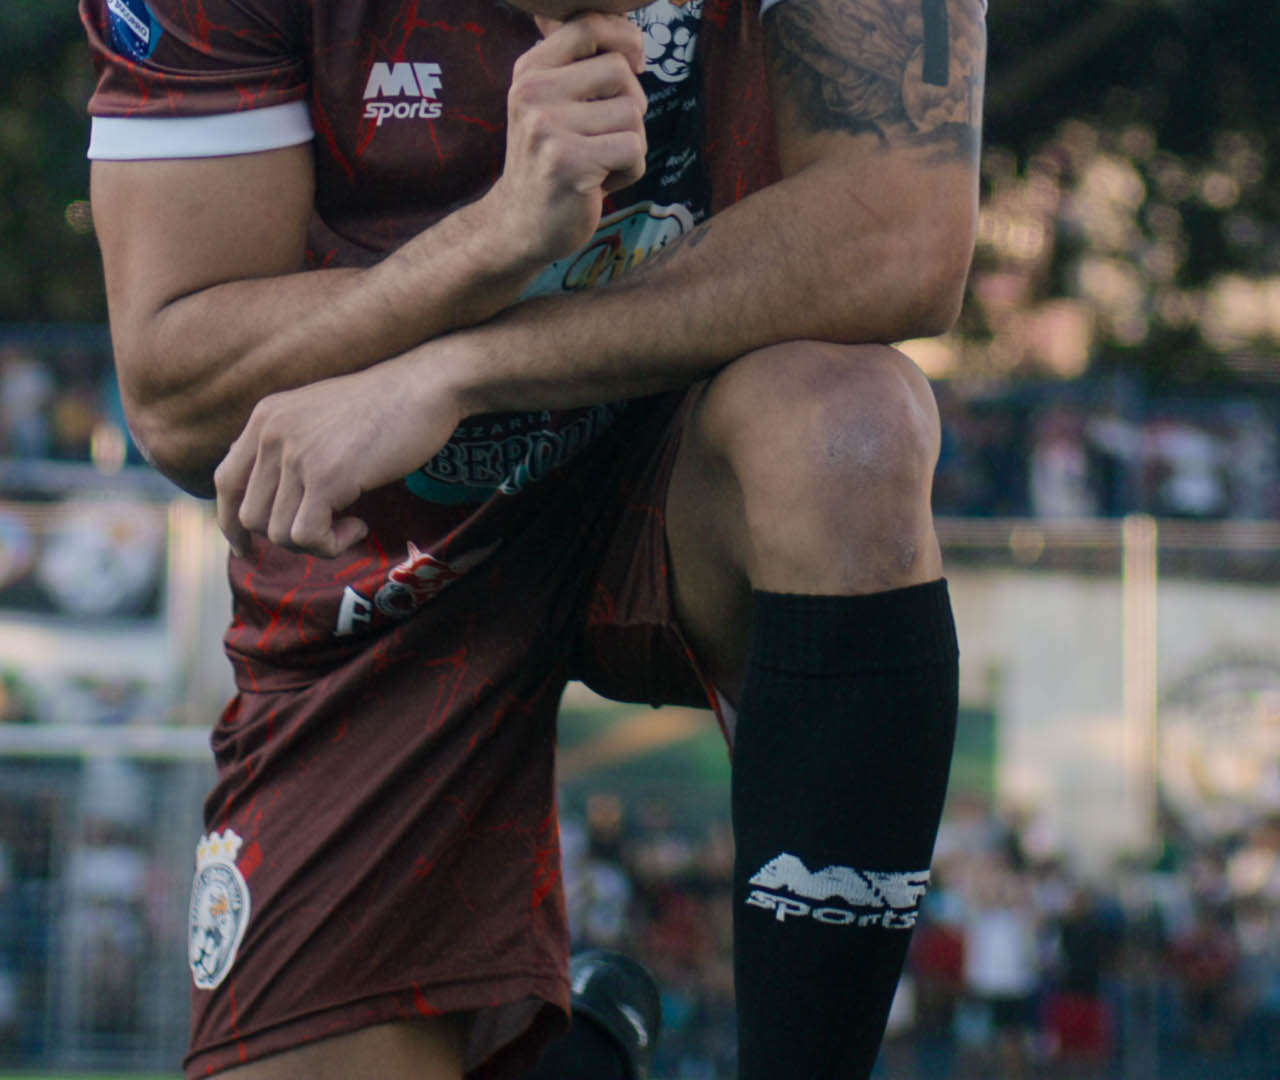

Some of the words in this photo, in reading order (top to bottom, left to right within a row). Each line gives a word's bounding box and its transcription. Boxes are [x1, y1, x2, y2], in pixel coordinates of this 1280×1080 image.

[362, 62, 443, 99] MF
[363, 99, 443, 126] sports
[745, 889, 919, 930] sports
